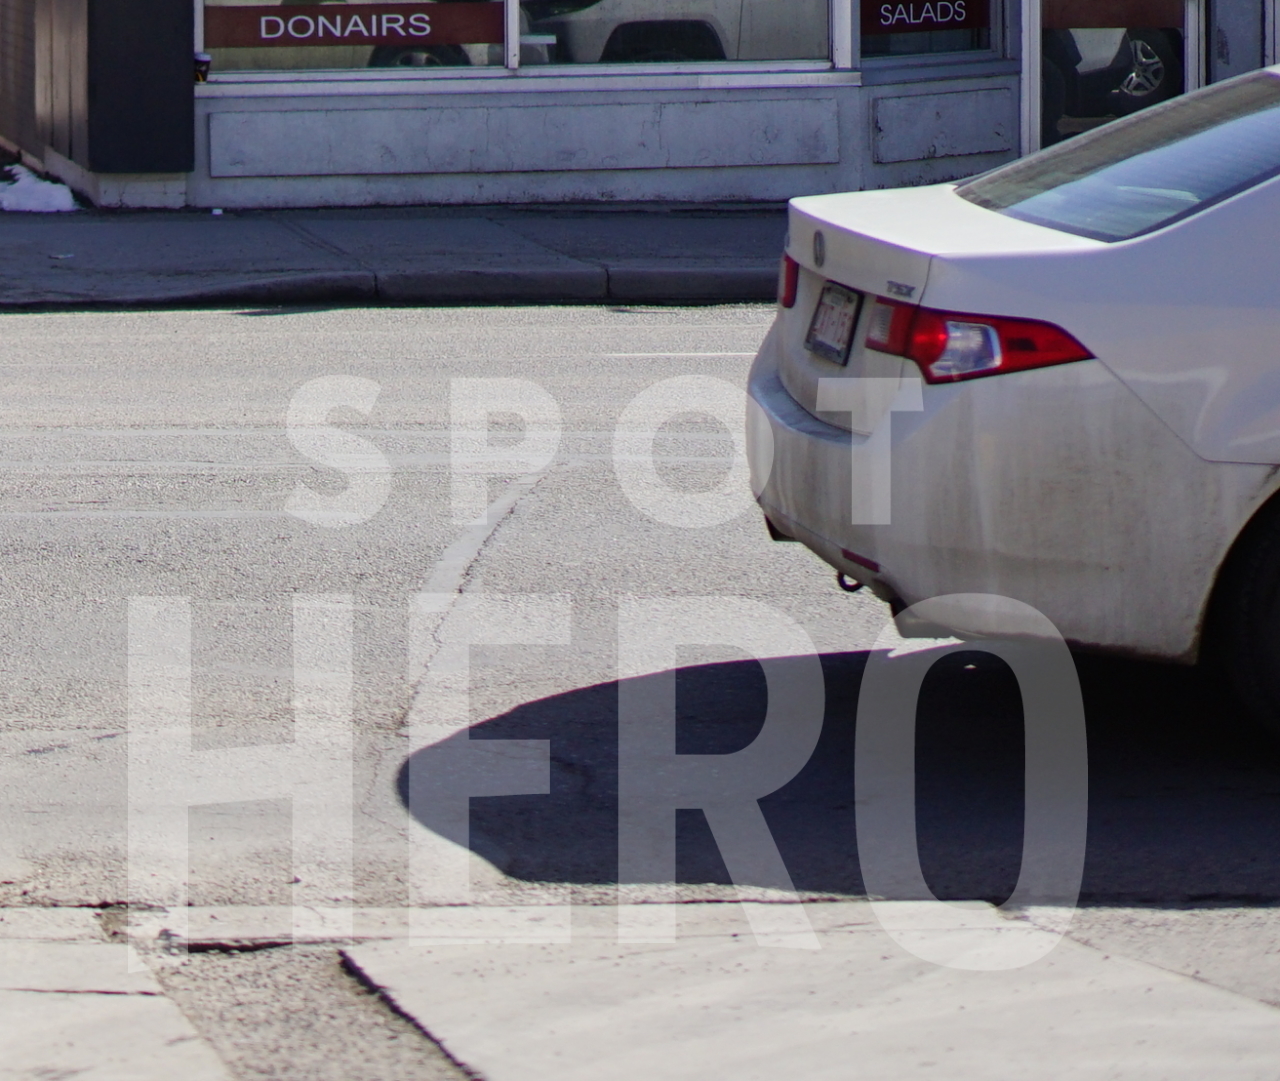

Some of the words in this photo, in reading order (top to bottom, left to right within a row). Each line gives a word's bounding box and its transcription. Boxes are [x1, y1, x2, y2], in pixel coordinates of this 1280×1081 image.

[260, 13, 432, 39] DONAIRS
[879, 0, 967, 26] SALADS
[886, 280, 916, 298] TSX
